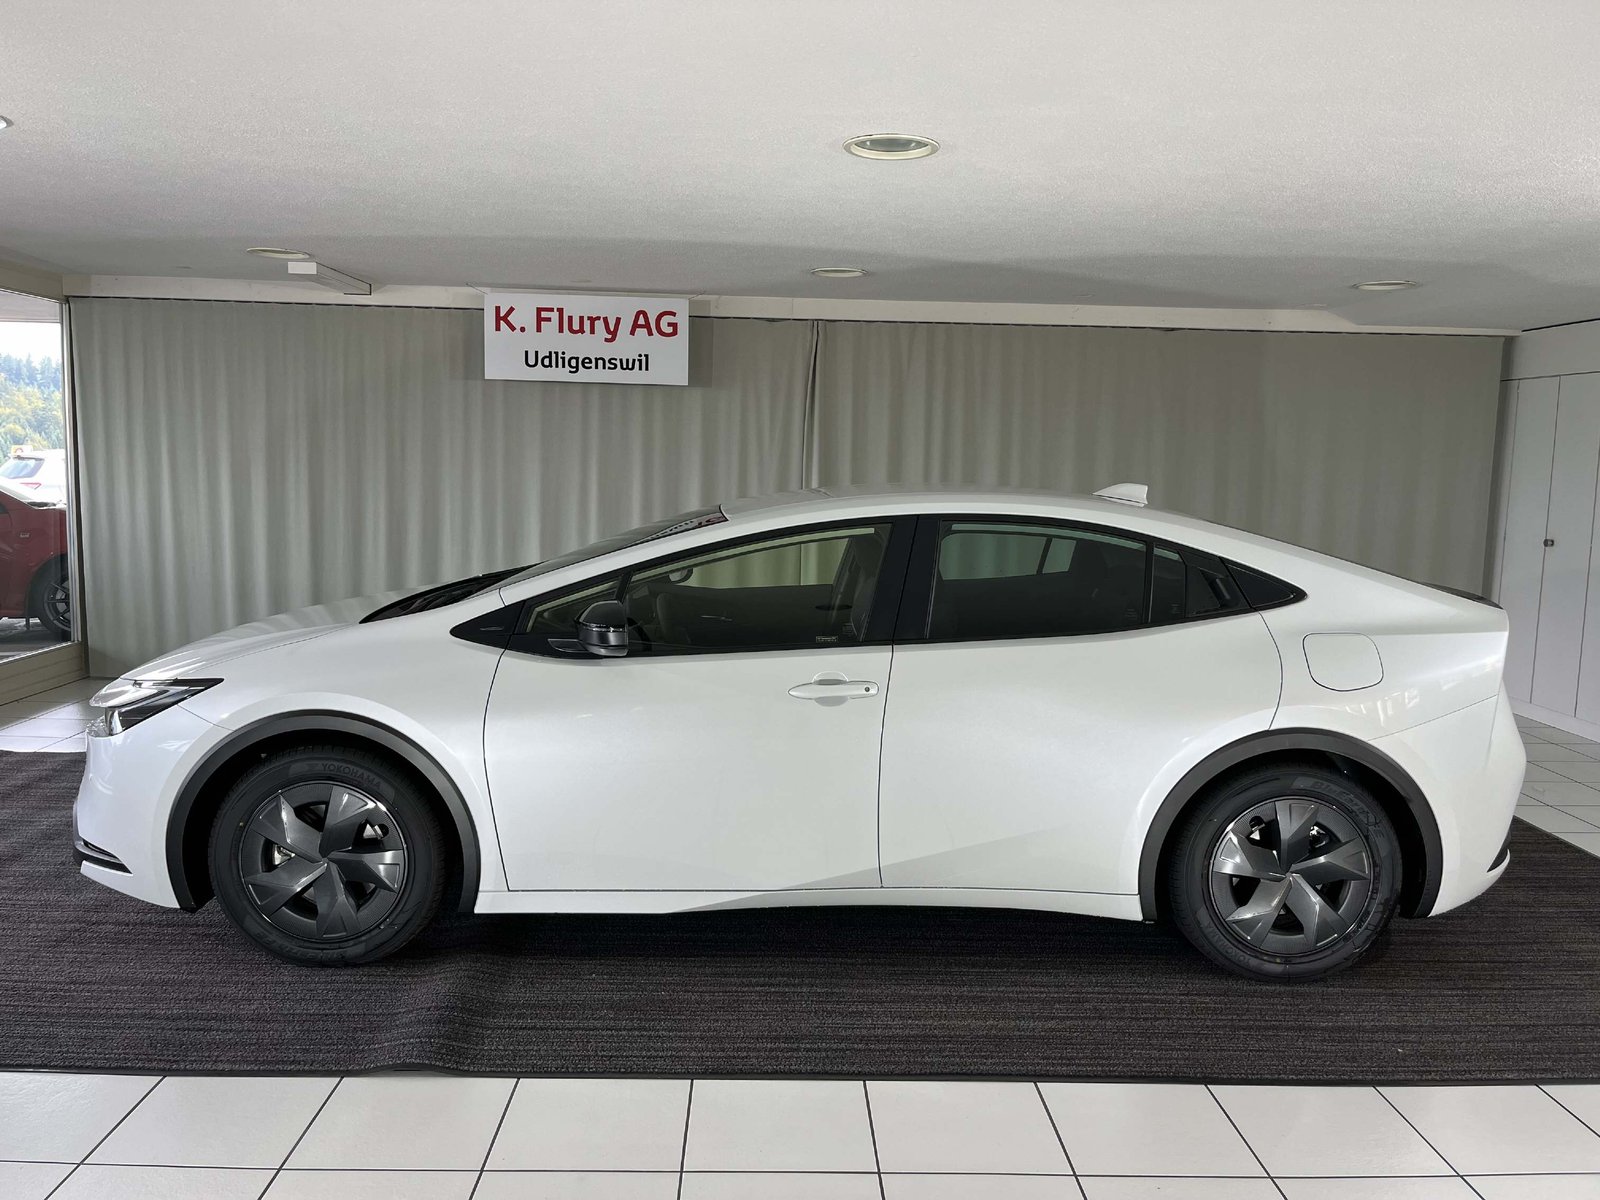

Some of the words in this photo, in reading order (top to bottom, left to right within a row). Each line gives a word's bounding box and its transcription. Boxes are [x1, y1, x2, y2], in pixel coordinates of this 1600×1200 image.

[494, 305, 526, 333] K.
[535, 306, 622, 343] Flury
[629, 309, 680, 338] AG
[524, 350, 650, 374] Udligenswil
[321, 762, 381, 789] YOKOHAMA
